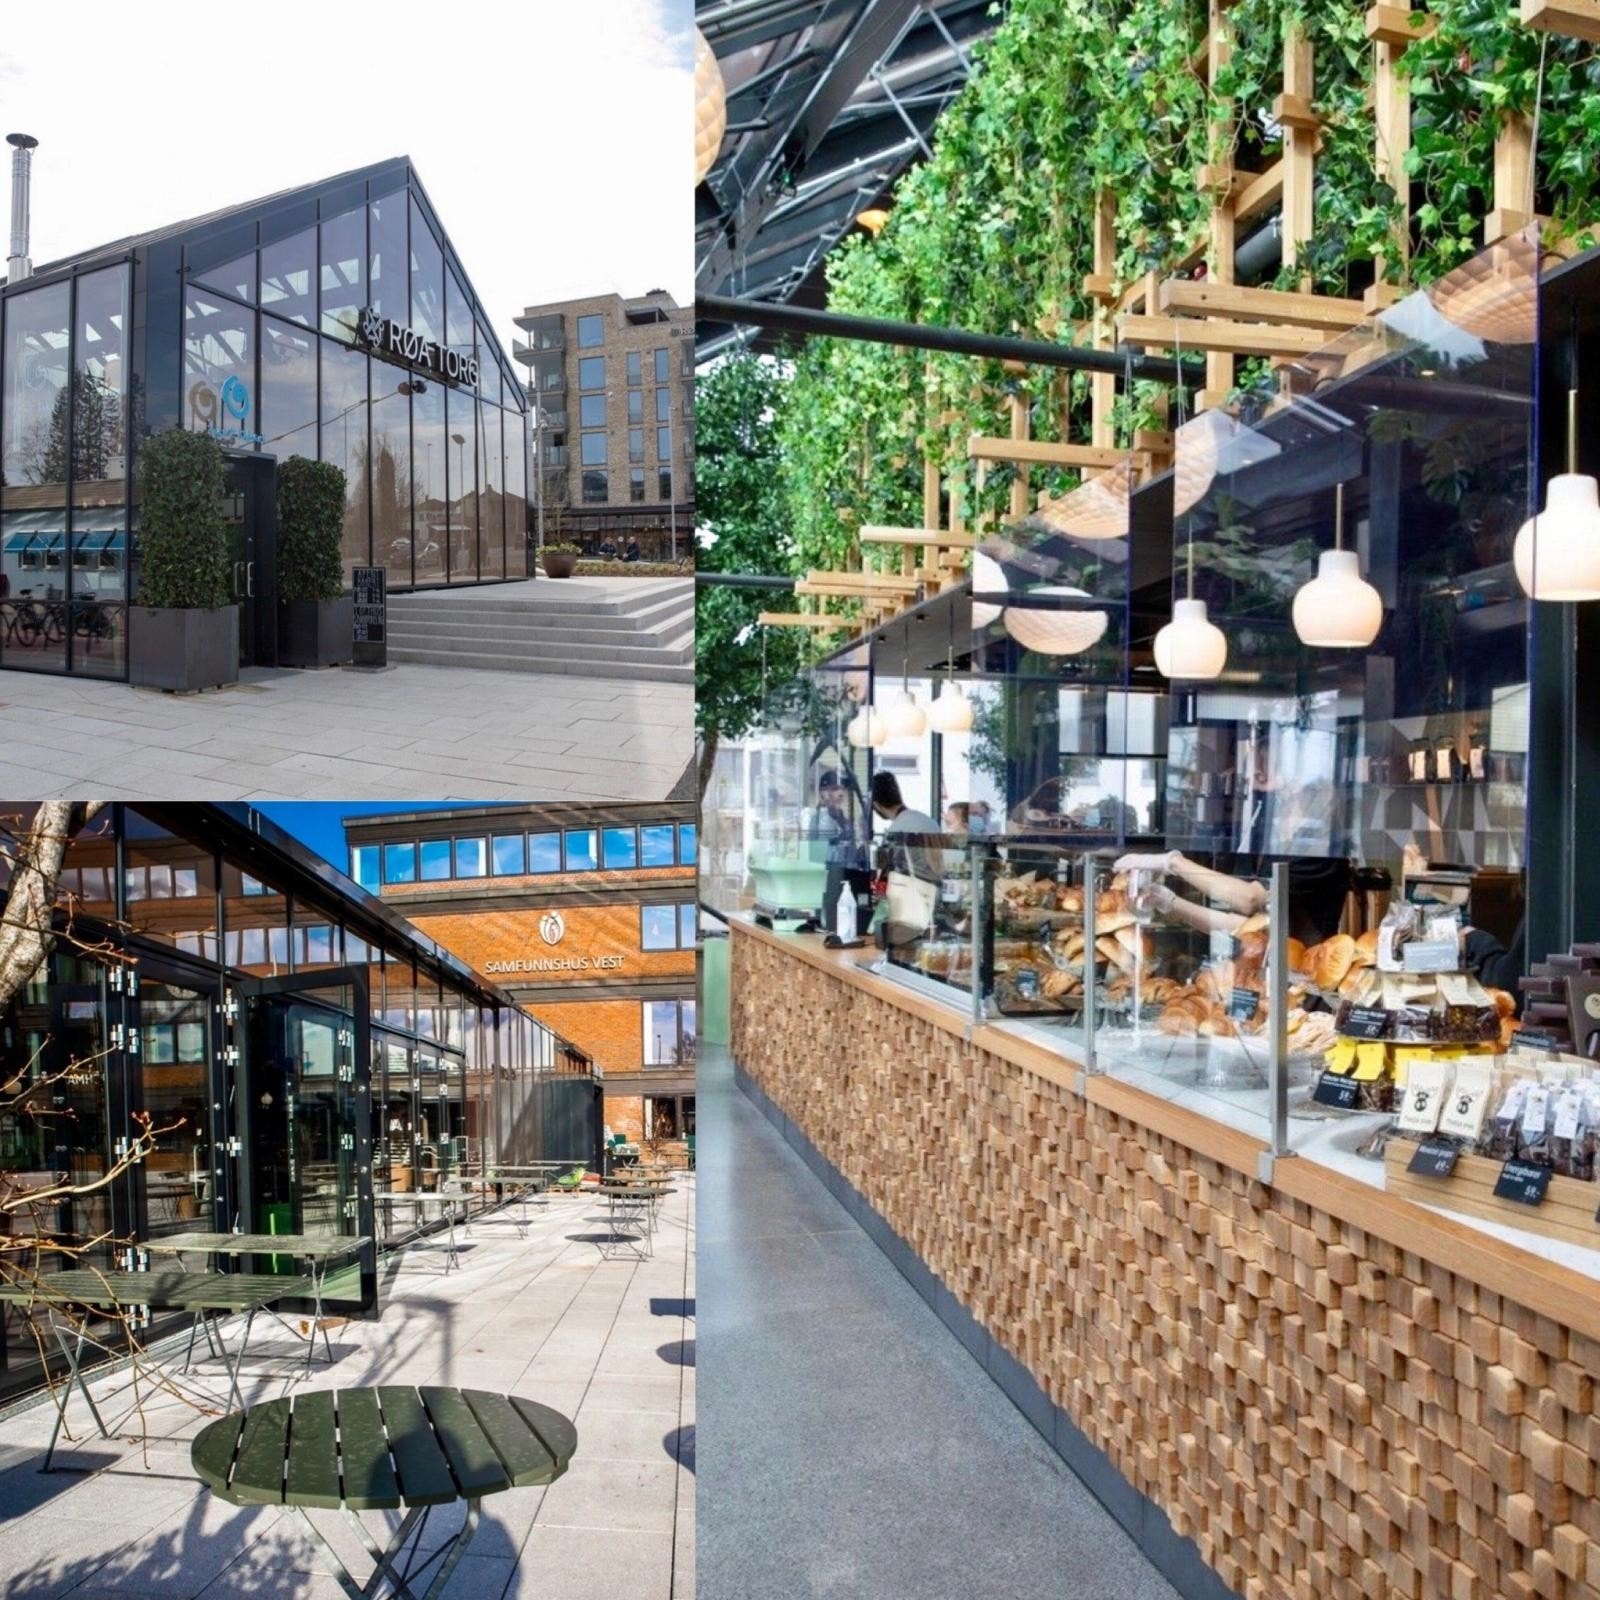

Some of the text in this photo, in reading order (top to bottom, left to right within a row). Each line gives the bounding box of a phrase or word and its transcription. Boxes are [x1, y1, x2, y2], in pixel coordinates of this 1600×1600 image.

[389, 320, 480, 387] RØA TORG
[485, 955, 625, 973] SAMFUNNSHUS VEST
